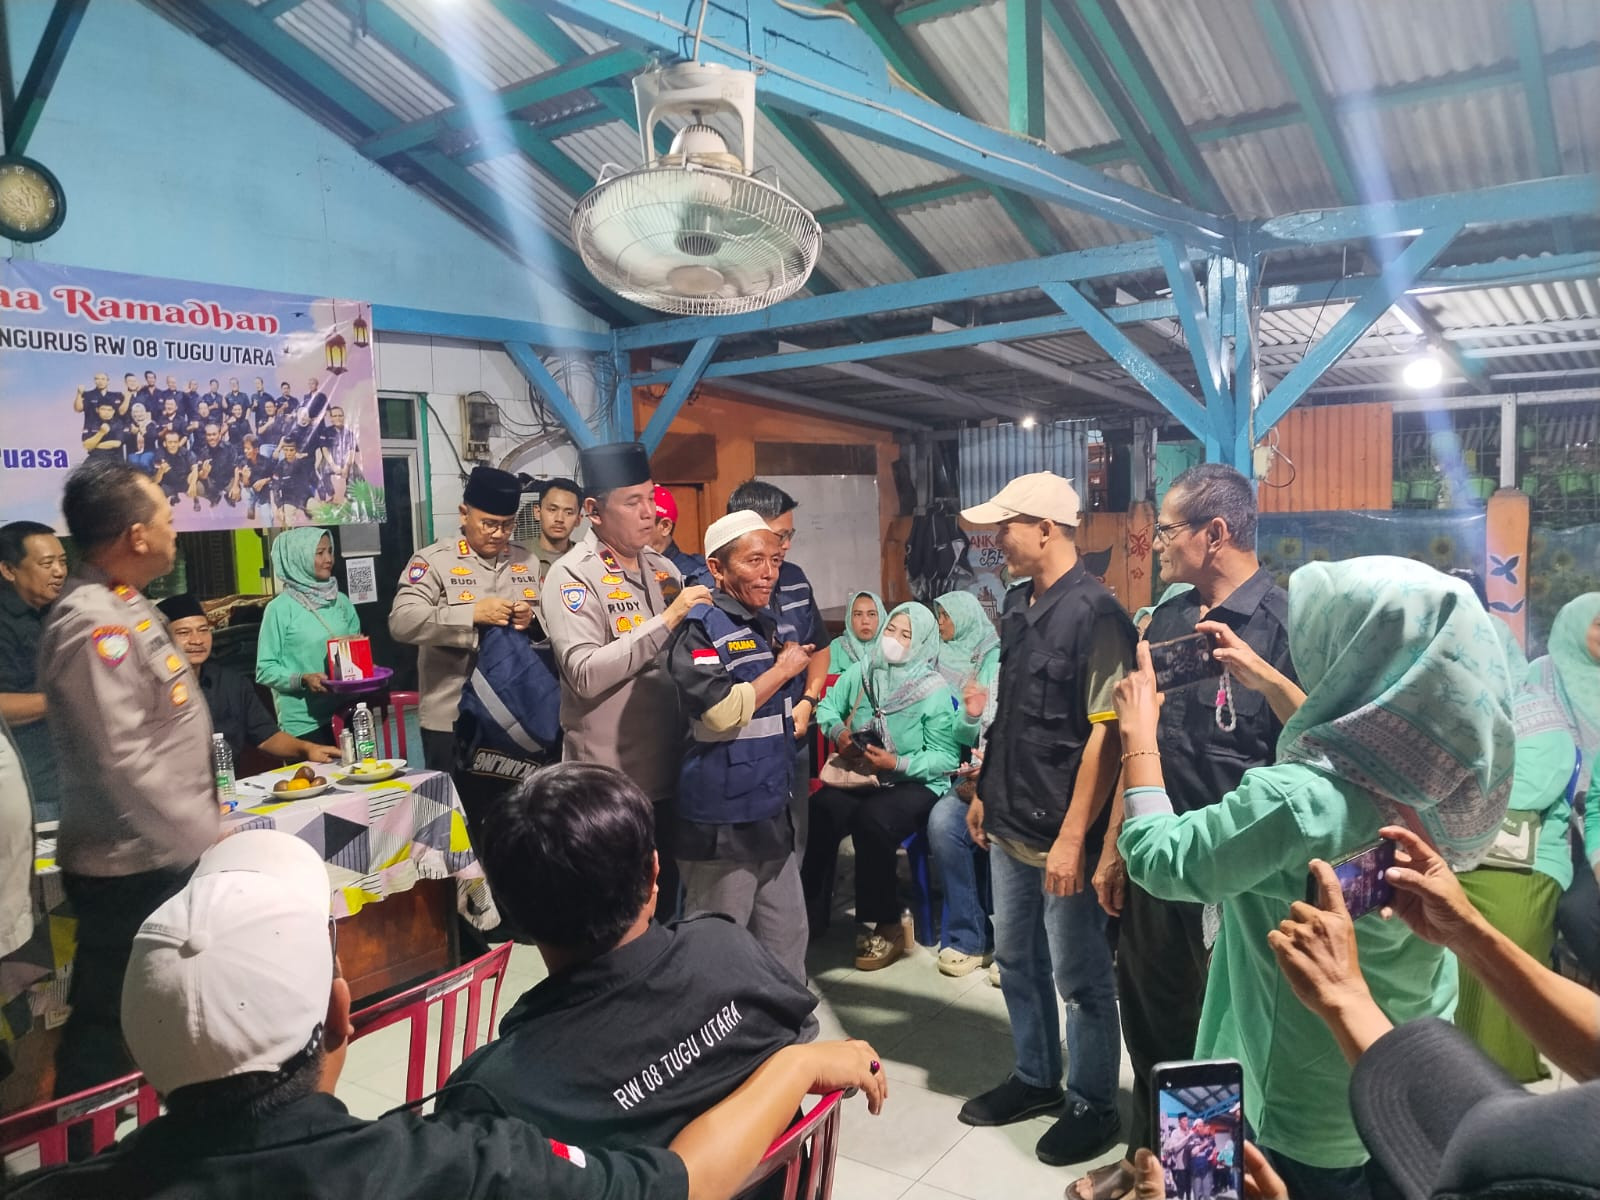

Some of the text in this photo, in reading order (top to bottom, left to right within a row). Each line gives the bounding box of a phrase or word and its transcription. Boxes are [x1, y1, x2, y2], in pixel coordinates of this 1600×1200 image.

[53, 289, 278, 335] Ramadhan
[94, 335, 126, 355] RW
[132, 338, 158, 358] 08
[164, 341, 214, 362] TUGU
[220, 344, 276, 367] UTARA
[0, 448, 69, 469] uasa
[450, 577, 477, 585] BUDI
[511, 575, 537, 583] POLRI
[607, 601, 640, 614] RUDY
[613, 1000, 742, 1110] RW 08 TUGU UTARA
